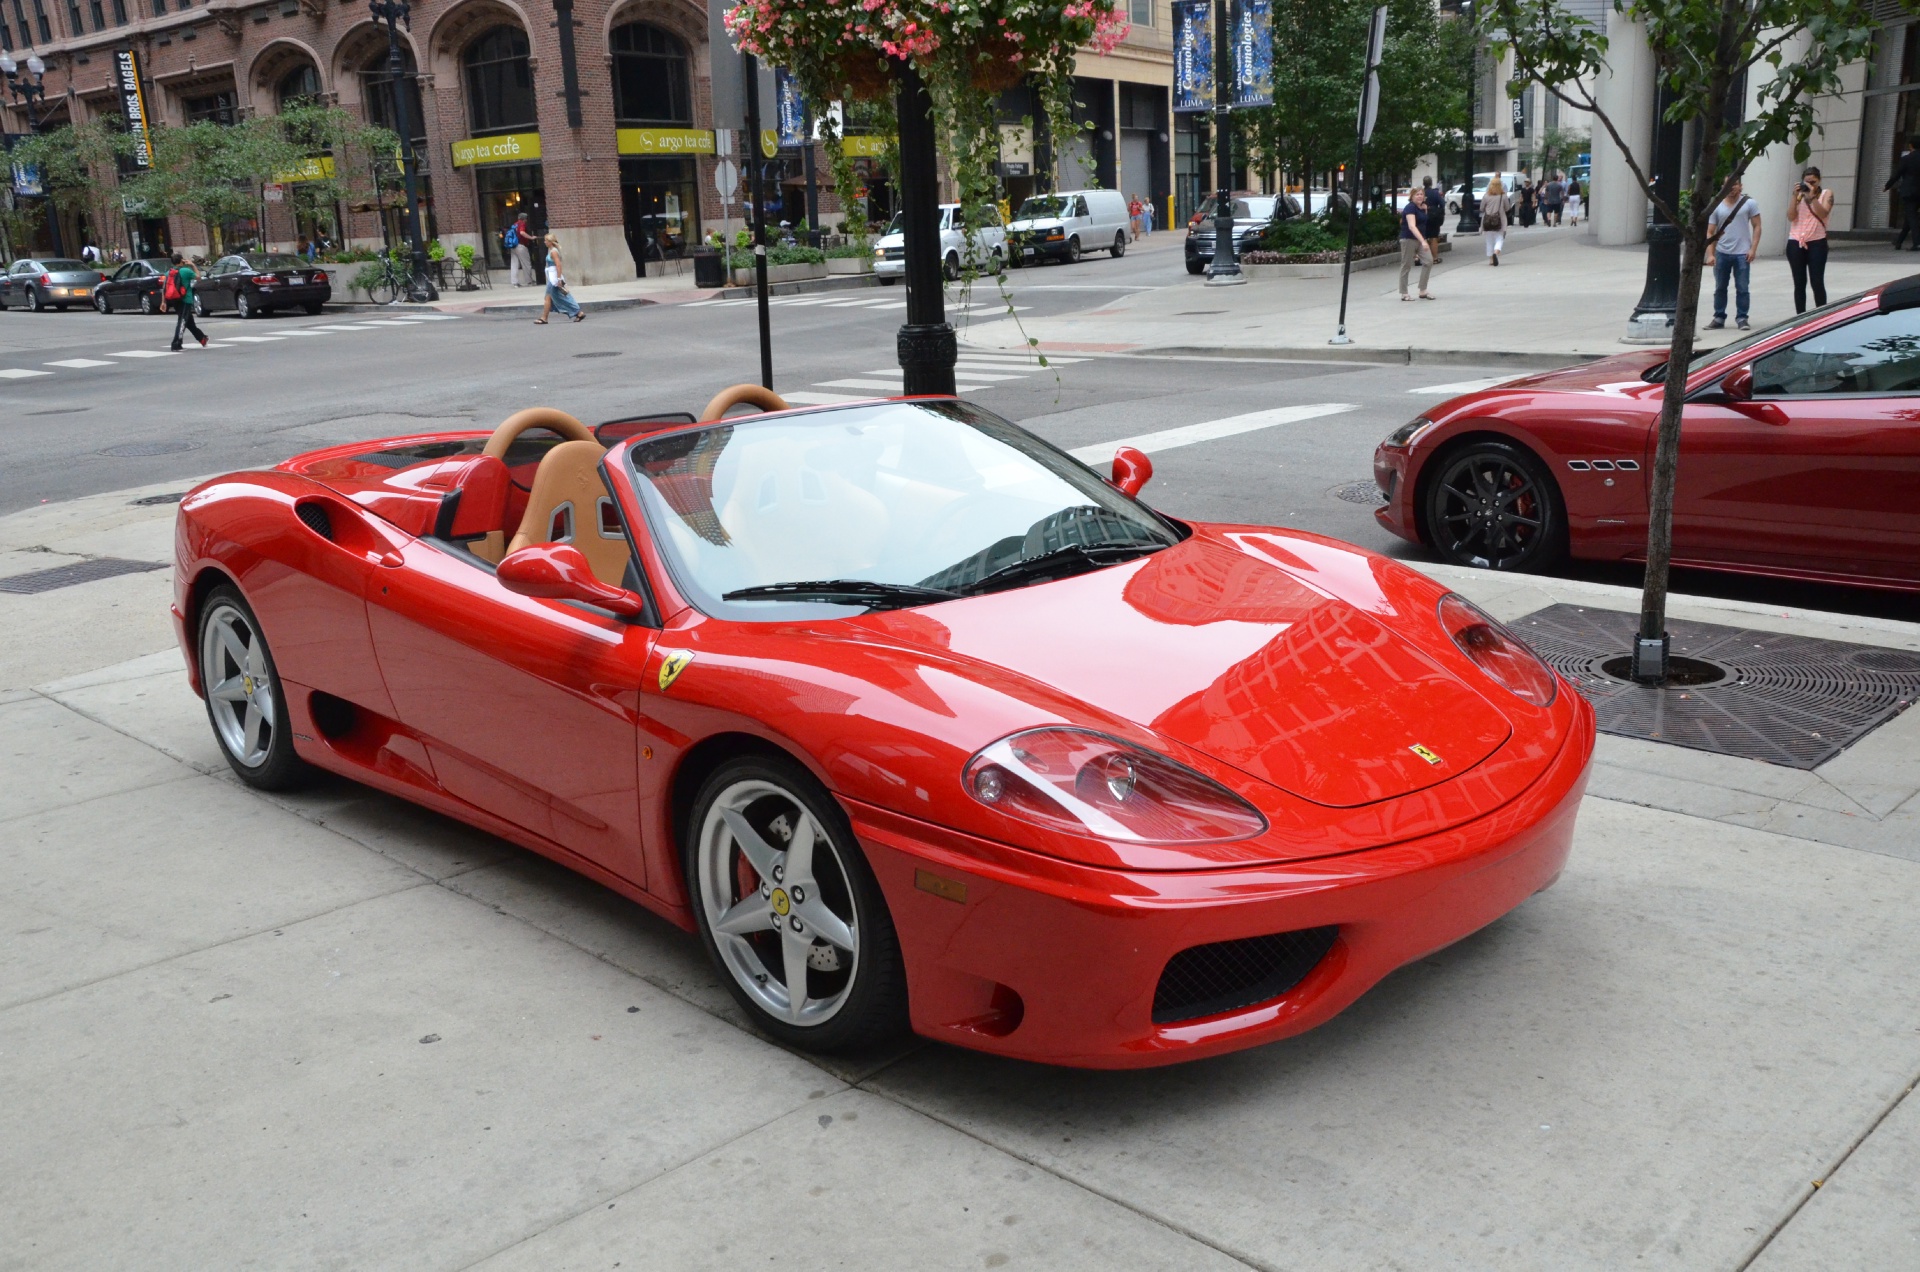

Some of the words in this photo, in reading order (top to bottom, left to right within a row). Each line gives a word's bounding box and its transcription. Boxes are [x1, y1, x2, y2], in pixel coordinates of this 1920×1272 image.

[1182, 17, 1194, 90] Cosmologies
[1241, 11, 1255, 85] Cosmologies
[118, 52, 138, 91] BAGELS
[127, 92, 143, 120] BROS.
[783, 80, 793, 133] Cosmologies
[1180, 99, 1204, 107] LUMA
[1240, 94, 1264, 103] LUMA
[1513, 99, 1523, 123] rack
[461, 146, 476, 162] argo
[476, 145, 491, 158] tea
[492, 136, 520, 156] café
[659, 136, 682, 151] argo
[684, 135, 697, 148] tea
